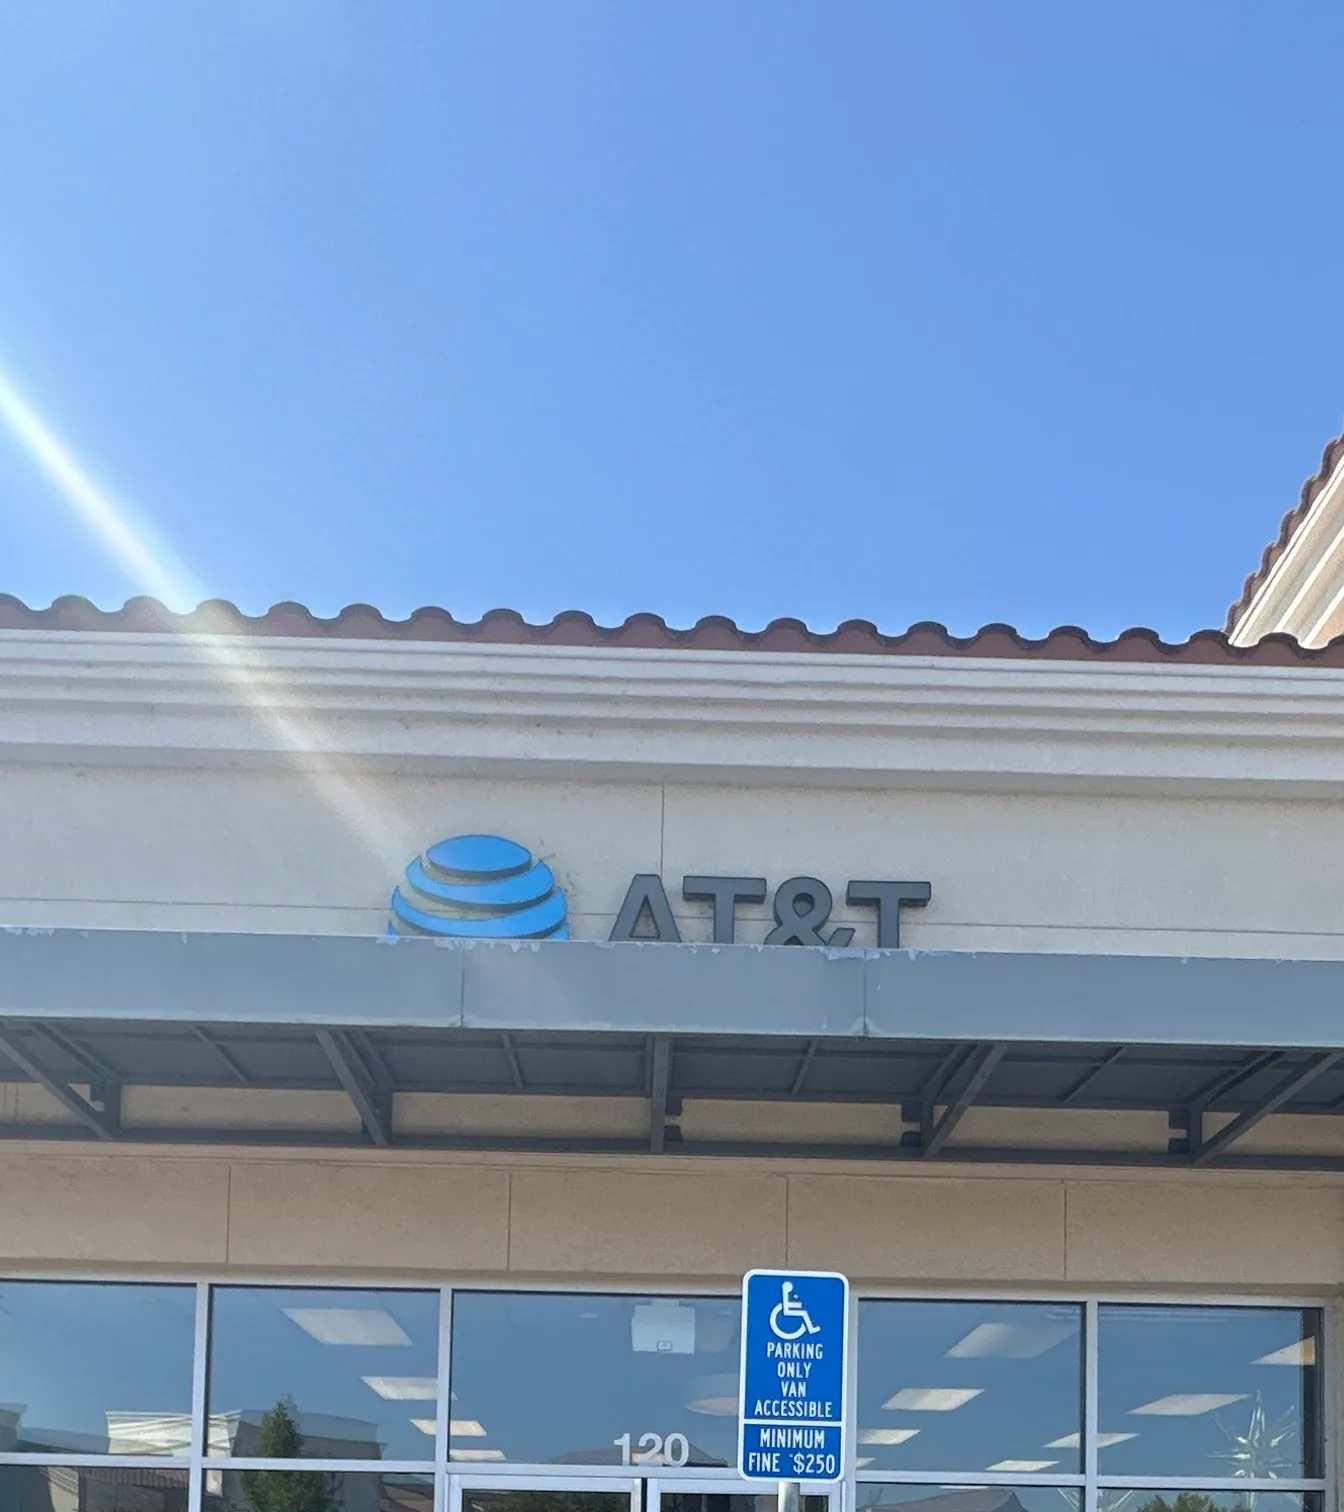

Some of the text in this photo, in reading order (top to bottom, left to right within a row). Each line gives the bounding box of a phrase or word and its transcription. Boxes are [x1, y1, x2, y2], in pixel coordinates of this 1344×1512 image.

[609, 874, 932, 950] AT&T
[767, 1342, 824, 1360] PARKING
[777, 1362, 812, 1378] ONLY
[781, 1381, 807, 1397] VAN
[754, 1400, 833, 1418] ACCESSIBLE
[760, 1428, 825, 1449] MINIMUM
[613, 1432, 690, 1467] 120
[748, 1452, 836, 1474] FINE $250
